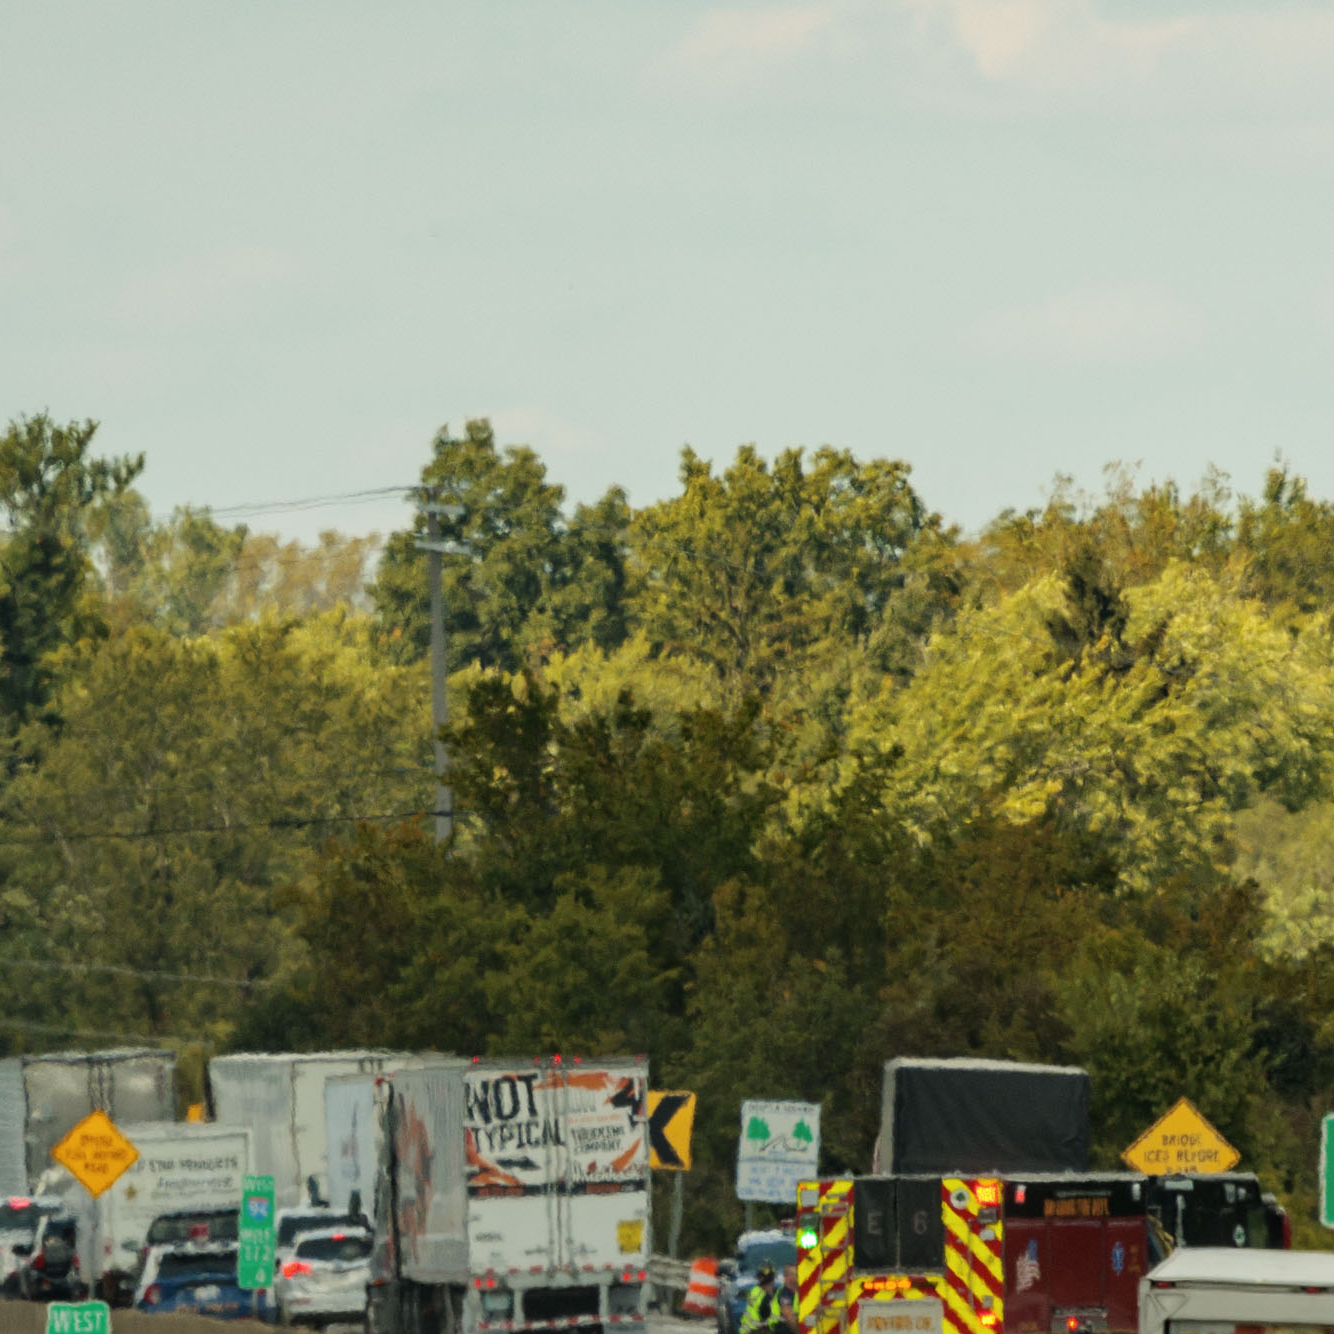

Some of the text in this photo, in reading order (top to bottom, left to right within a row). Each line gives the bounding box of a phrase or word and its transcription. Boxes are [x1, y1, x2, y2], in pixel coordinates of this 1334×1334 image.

[466, 1073, 539, 1125] NOT
[473, 1119, 566, 1152] TYPICAL
[868, 1211, 928, 1235] E 6
[52, 1311, 103, 1333] WEST
